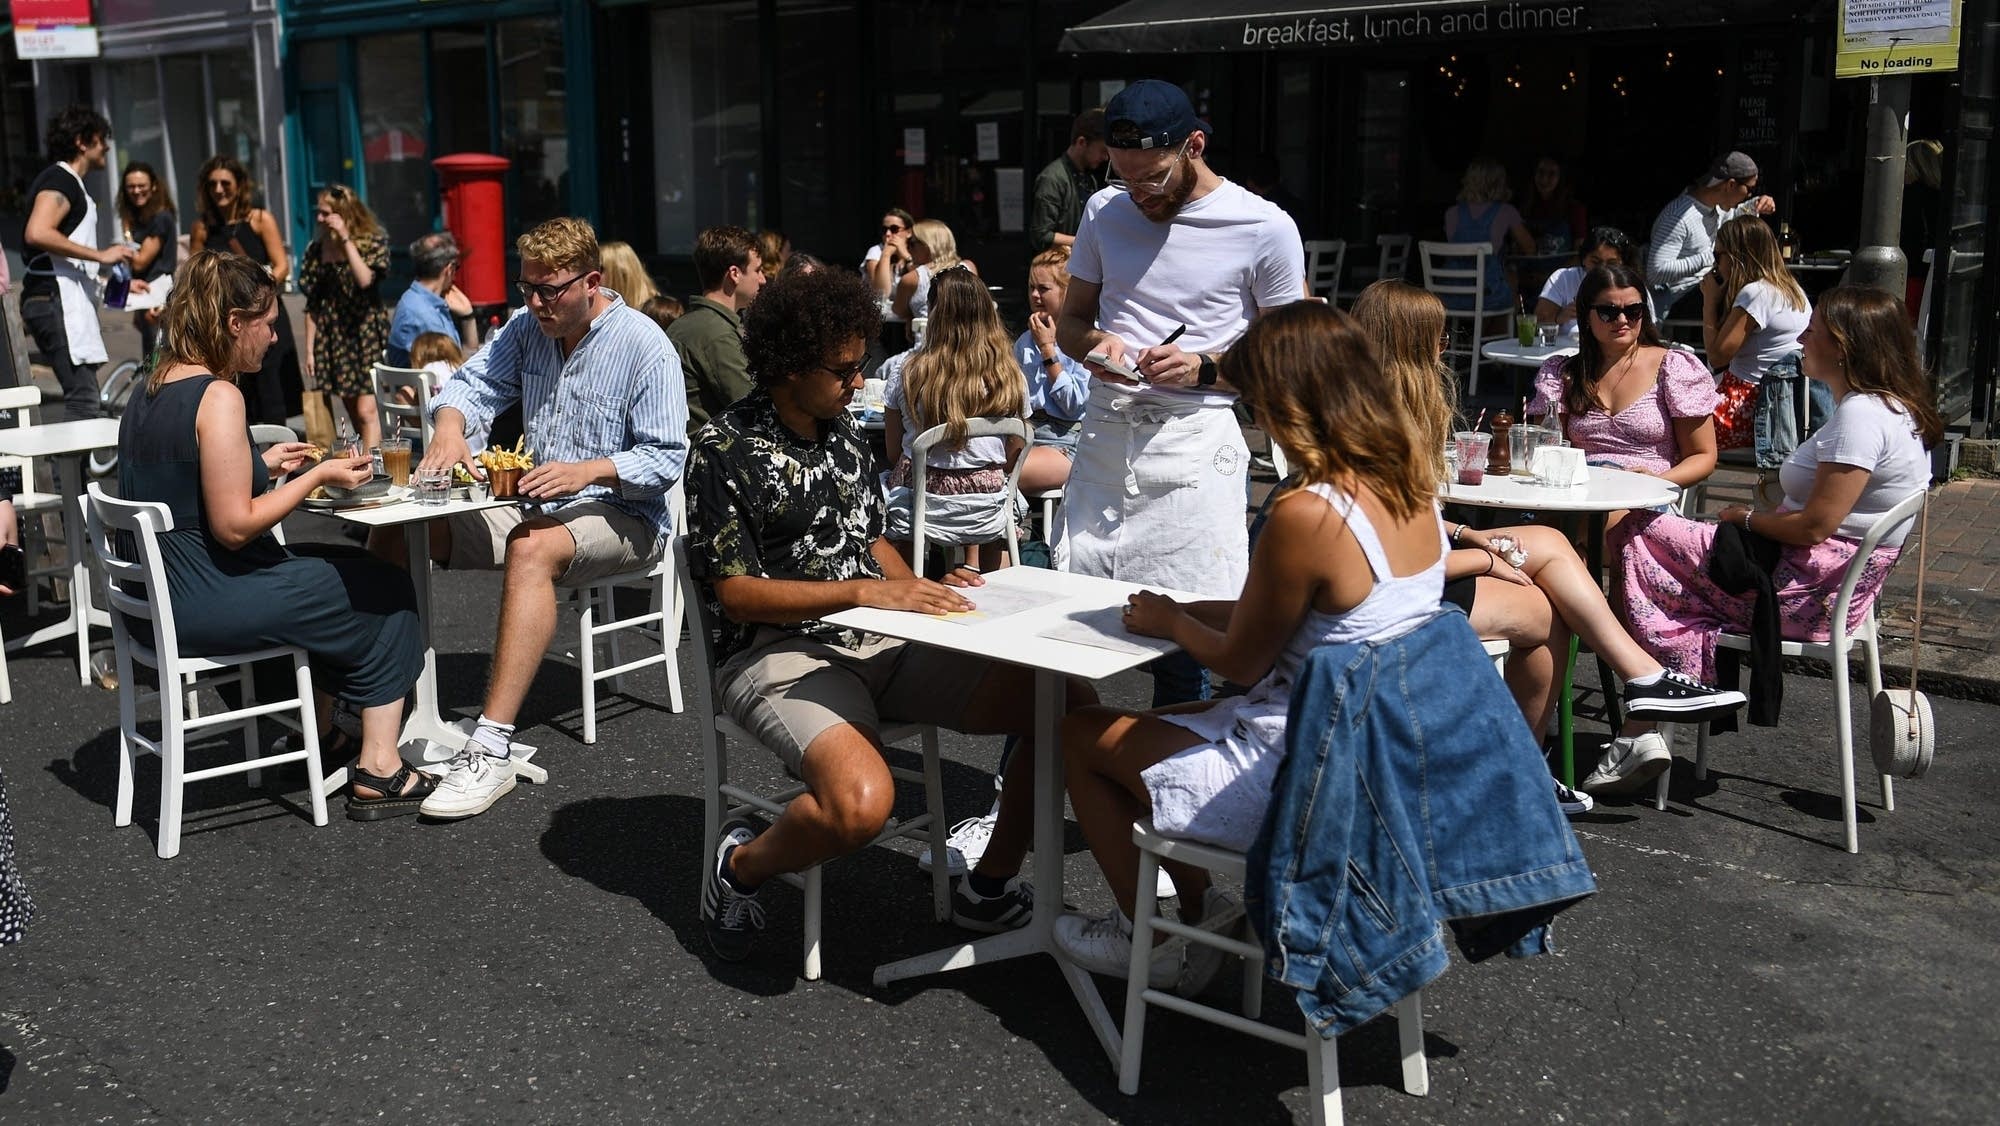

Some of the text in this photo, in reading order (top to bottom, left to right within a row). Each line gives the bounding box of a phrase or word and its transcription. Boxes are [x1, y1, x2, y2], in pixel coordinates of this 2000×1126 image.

[1849, 7, 1899, 17] NORTHCOTE
[1243, 3, 1585, 45] breakfast, lunch and dinner
[1860, 56, 1933, 69] No loading
